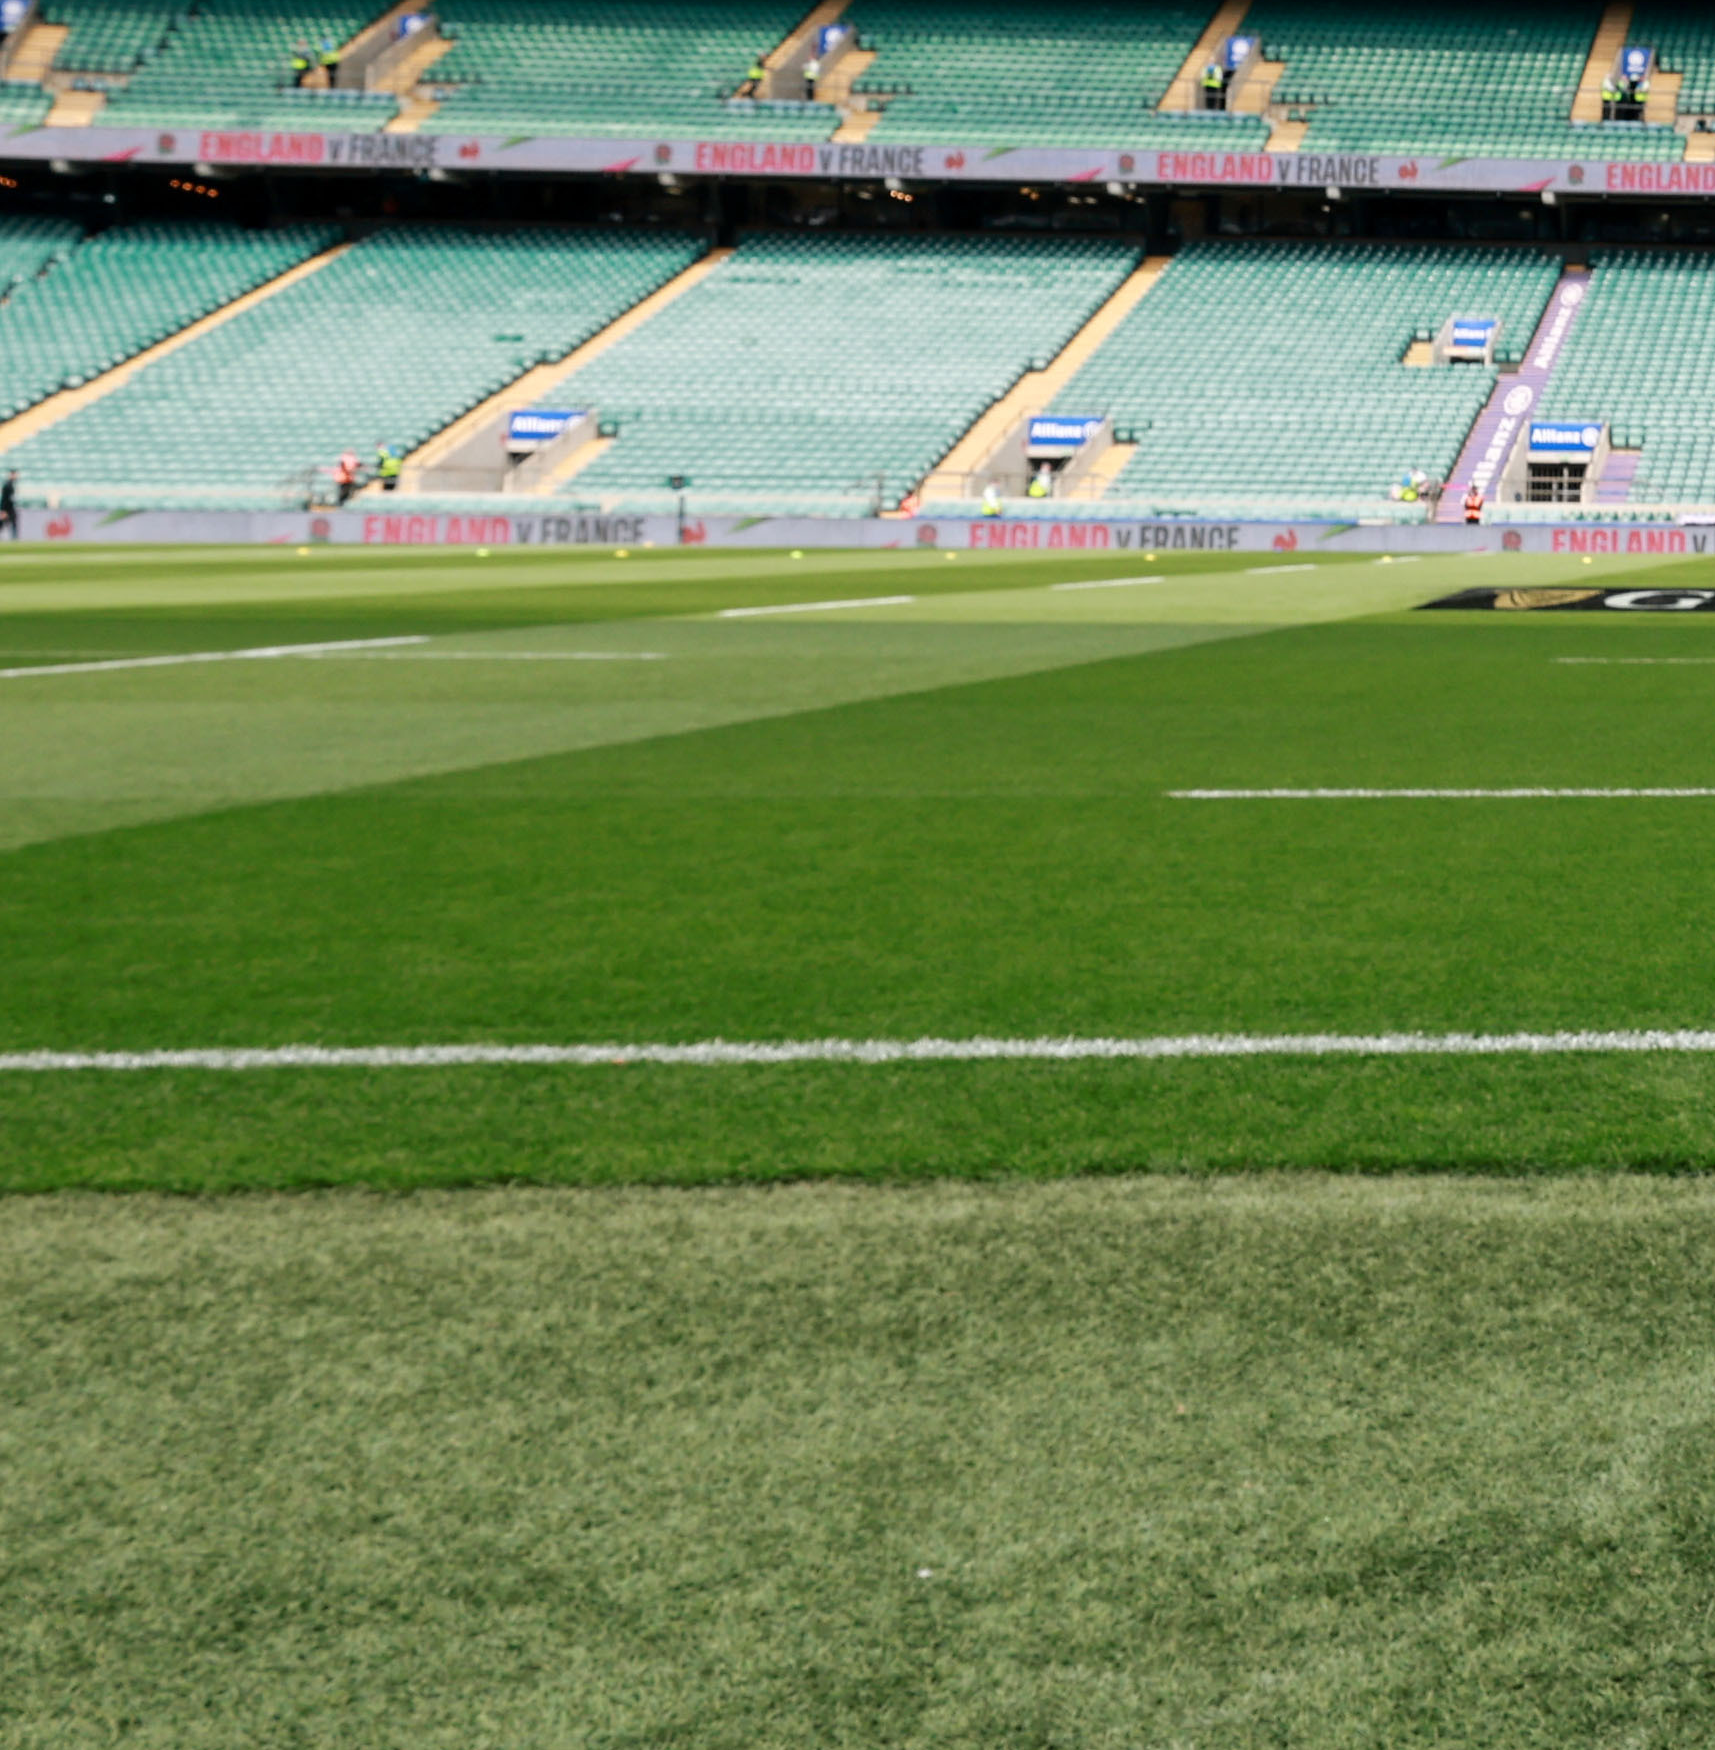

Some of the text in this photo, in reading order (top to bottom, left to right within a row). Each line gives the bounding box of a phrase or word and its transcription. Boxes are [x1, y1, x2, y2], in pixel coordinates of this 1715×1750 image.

[201, 132, 325, 162] ENGLAND
[347, 134, 436, 163] FRANCE
[695, 141, 815, 172] ENGLAND
[837, 145, 924, 175] FRANCE
[1158, 152, 1274, 180] ENGLAND
[1298, 155, 1379, 183] FRANCE
[1534, 306, 1572, 369] Allianz
[1531, 428, 1580, 444] Allianz
[363, 516, 511, 543] ENGLAND
[540, 517, 647, 544] FRANCE
[969, 523, 1109, 548] ENGLAND
[1140, 525, 1240, 549] FRANCE
[1552, 529, 1686, 553] ENGLAND
